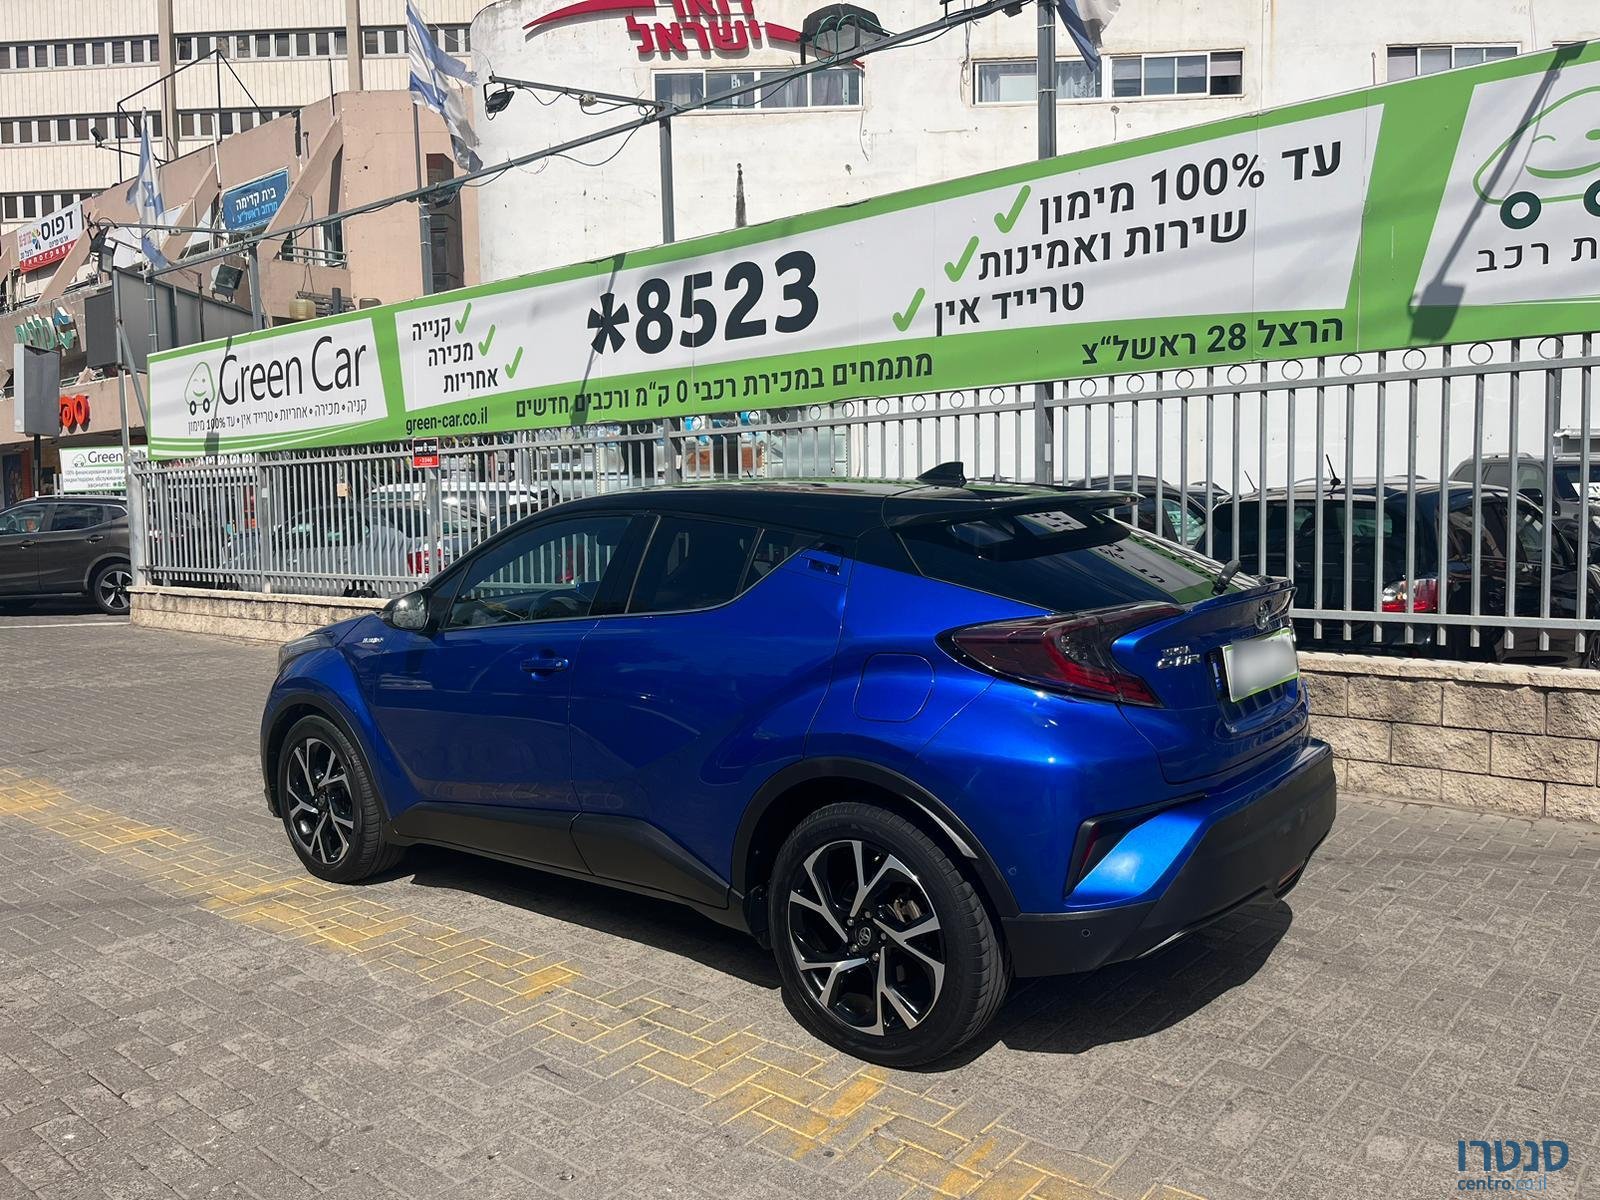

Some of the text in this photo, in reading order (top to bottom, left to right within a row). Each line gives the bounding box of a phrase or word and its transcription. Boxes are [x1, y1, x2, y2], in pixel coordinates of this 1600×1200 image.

[625, 15, 762, 53] ישראל
[261, 187, 277, 202] בית
[1040, 141, 1341, 235] עד 100% מימון
[40, 210, 74, 241] דפוס
[978, 208, 1247, 280] שירות ואמינות
[1476, 237, 1598, 273] ת רכב
[933, 281, 1085, 337] טרייד אין
[412, 317, 451, 342] קנייה
[1081, 318, 1343, 365] הרצל 28 ראשל"צ
[428, 342, 474, 367] מכירה
[832, 352, 933, 387] מתמחים
[218, 335, 366, 406] Green Car
[443, 367, 499, 394] אחריות
[742, 366, 825, 397] במכירת
[575, 389, 629, 412] ורכבים
[676, 379, 688, 403] 0
[693, 377, 736, 401] רכבי
[187, 399, 367, 435] קניה מכירה אחריות טרייד אין עד 100% מימון
[405, 406, 488, 435] green-car.co.il
[516, 395, 569, 418] חדשים
[87, 450, 124, 464] Green
